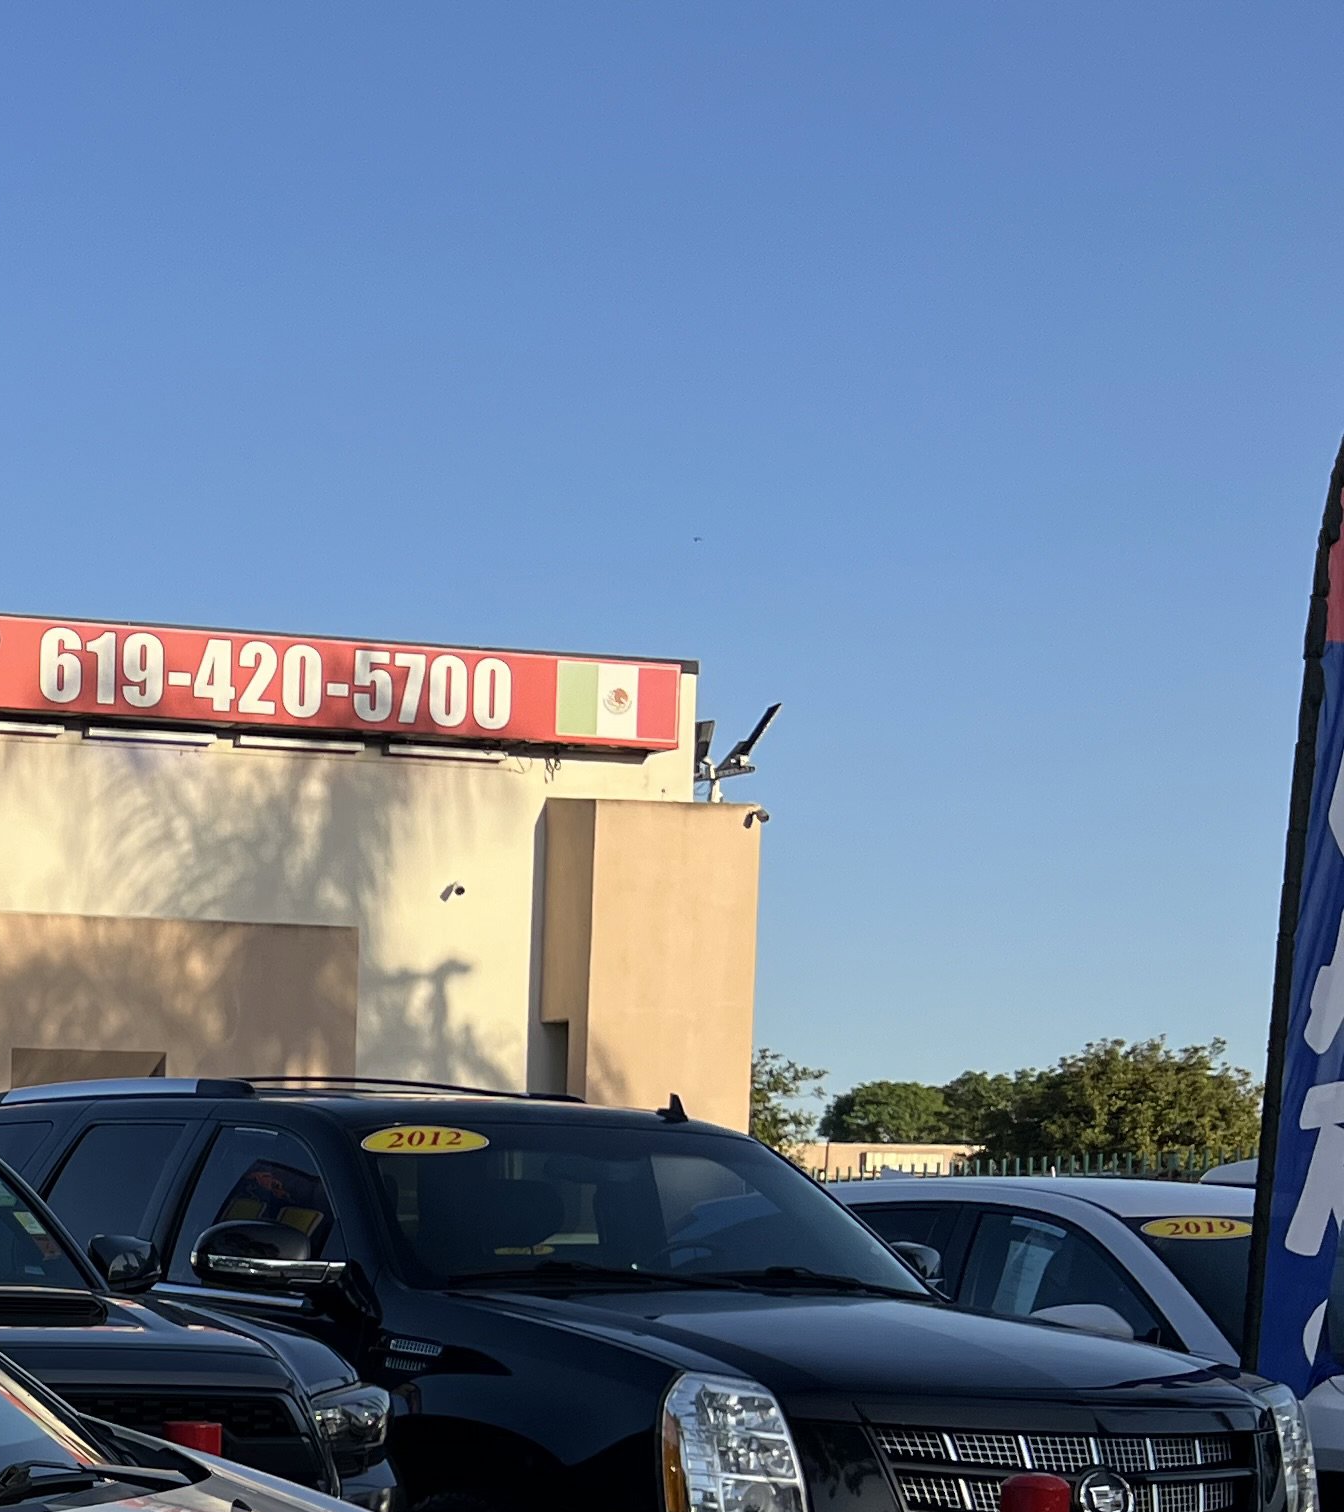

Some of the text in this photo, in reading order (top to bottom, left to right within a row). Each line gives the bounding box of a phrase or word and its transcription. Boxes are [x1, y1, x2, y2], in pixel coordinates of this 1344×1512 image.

[38, 626, 514, 730] 619-420-5700
[386, 1130, 463, 1149] 2012
[1165, 1220, 1236, 1236] 2019
